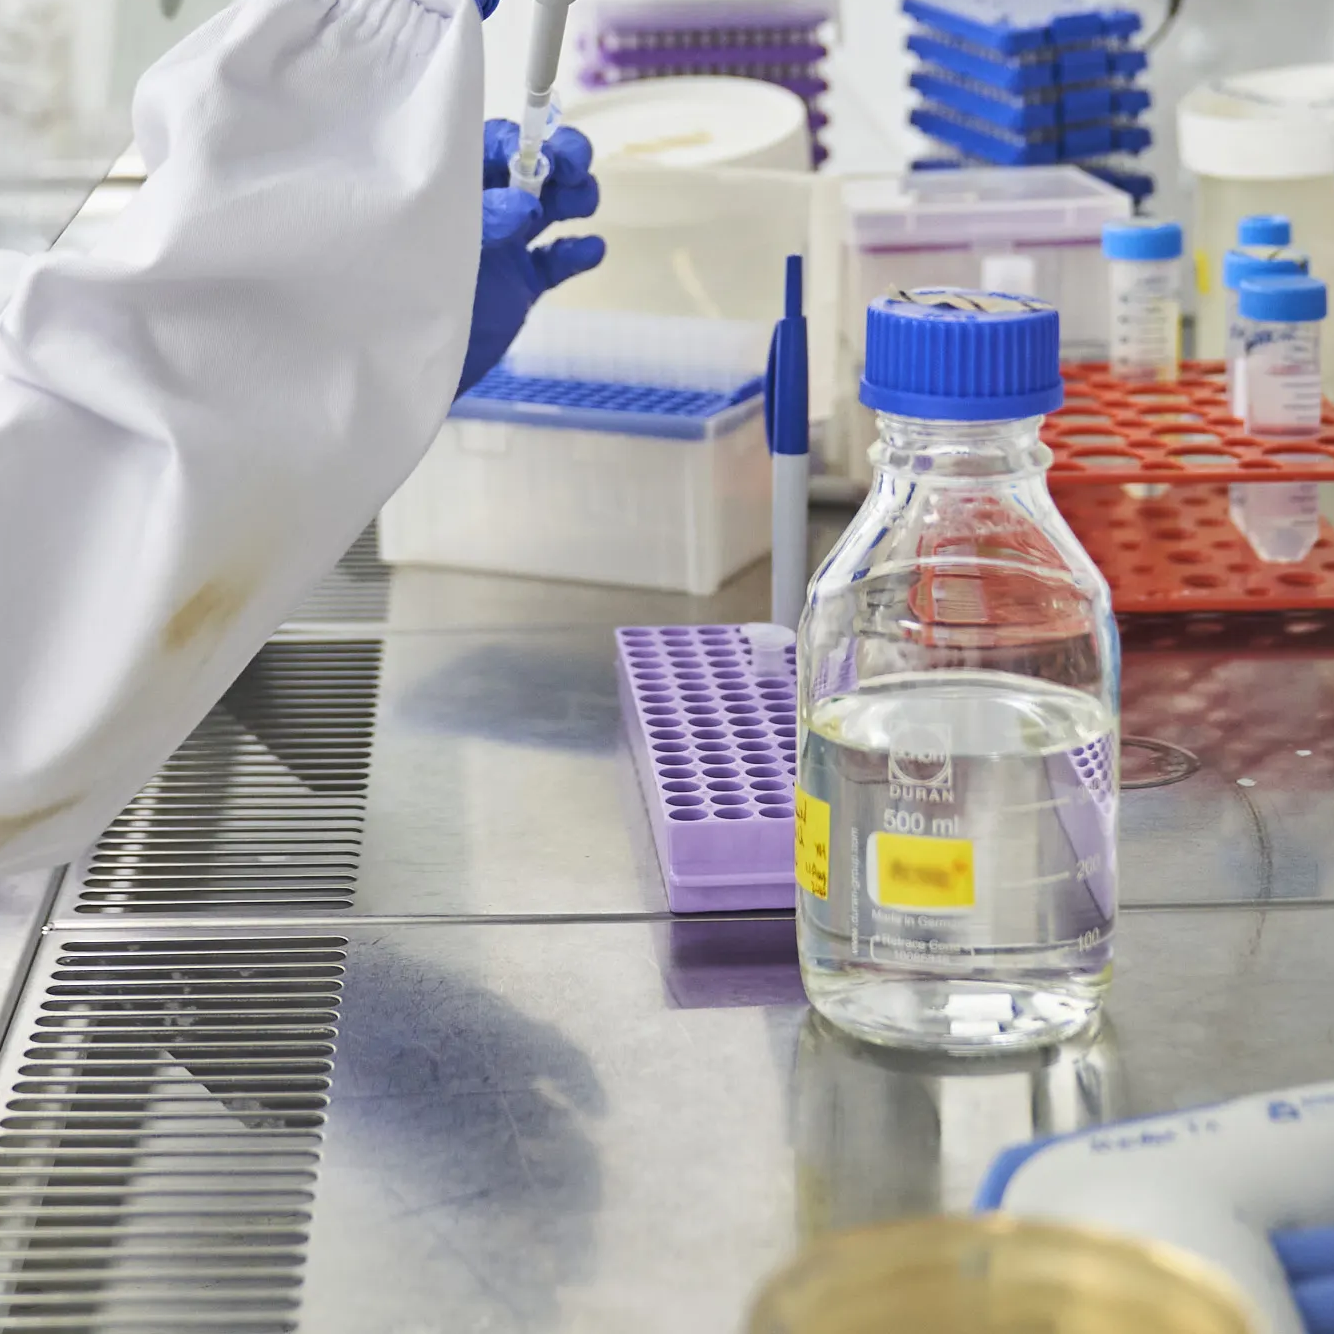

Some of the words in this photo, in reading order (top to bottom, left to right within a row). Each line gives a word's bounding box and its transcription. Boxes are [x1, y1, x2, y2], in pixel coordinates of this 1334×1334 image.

[889, 784, 955, 804] DURAN
[883, 808, 925, 832] 500
[932, 814, 959, 835] ml
[1076, 853, 1101, 882] 200
[904, 914, 916, 928] in
[1077, 926, 1100, 954] 100
